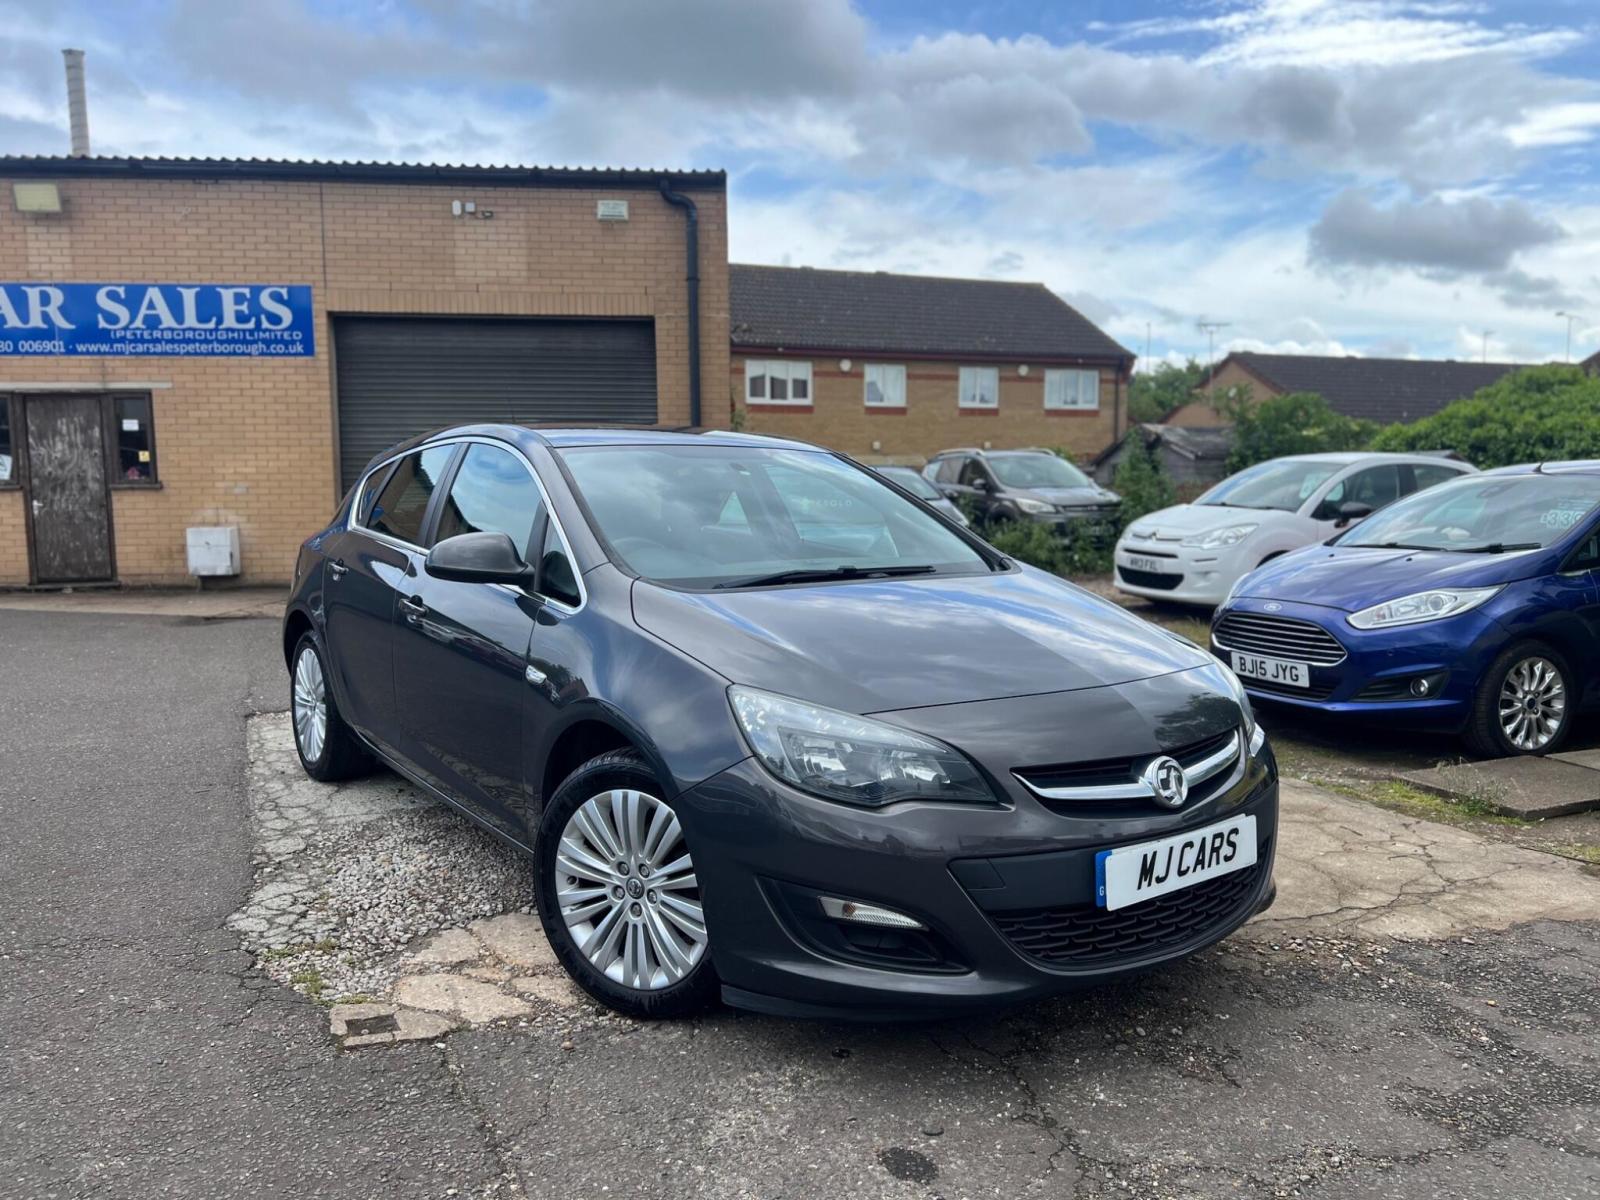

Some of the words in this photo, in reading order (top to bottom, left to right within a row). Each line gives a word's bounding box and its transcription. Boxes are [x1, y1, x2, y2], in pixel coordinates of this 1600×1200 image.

[95, 286, 294, 329] SALES
[245, 330, 303, 340] LIMITED
[18, 340, 66, 353] 006901
[75, 341, 305, 356] www.mjcarsalespeterborough.co.uk
[1238, 656, 1267, 677] BJ15
[1271, 663, 1299, 682] JYG
